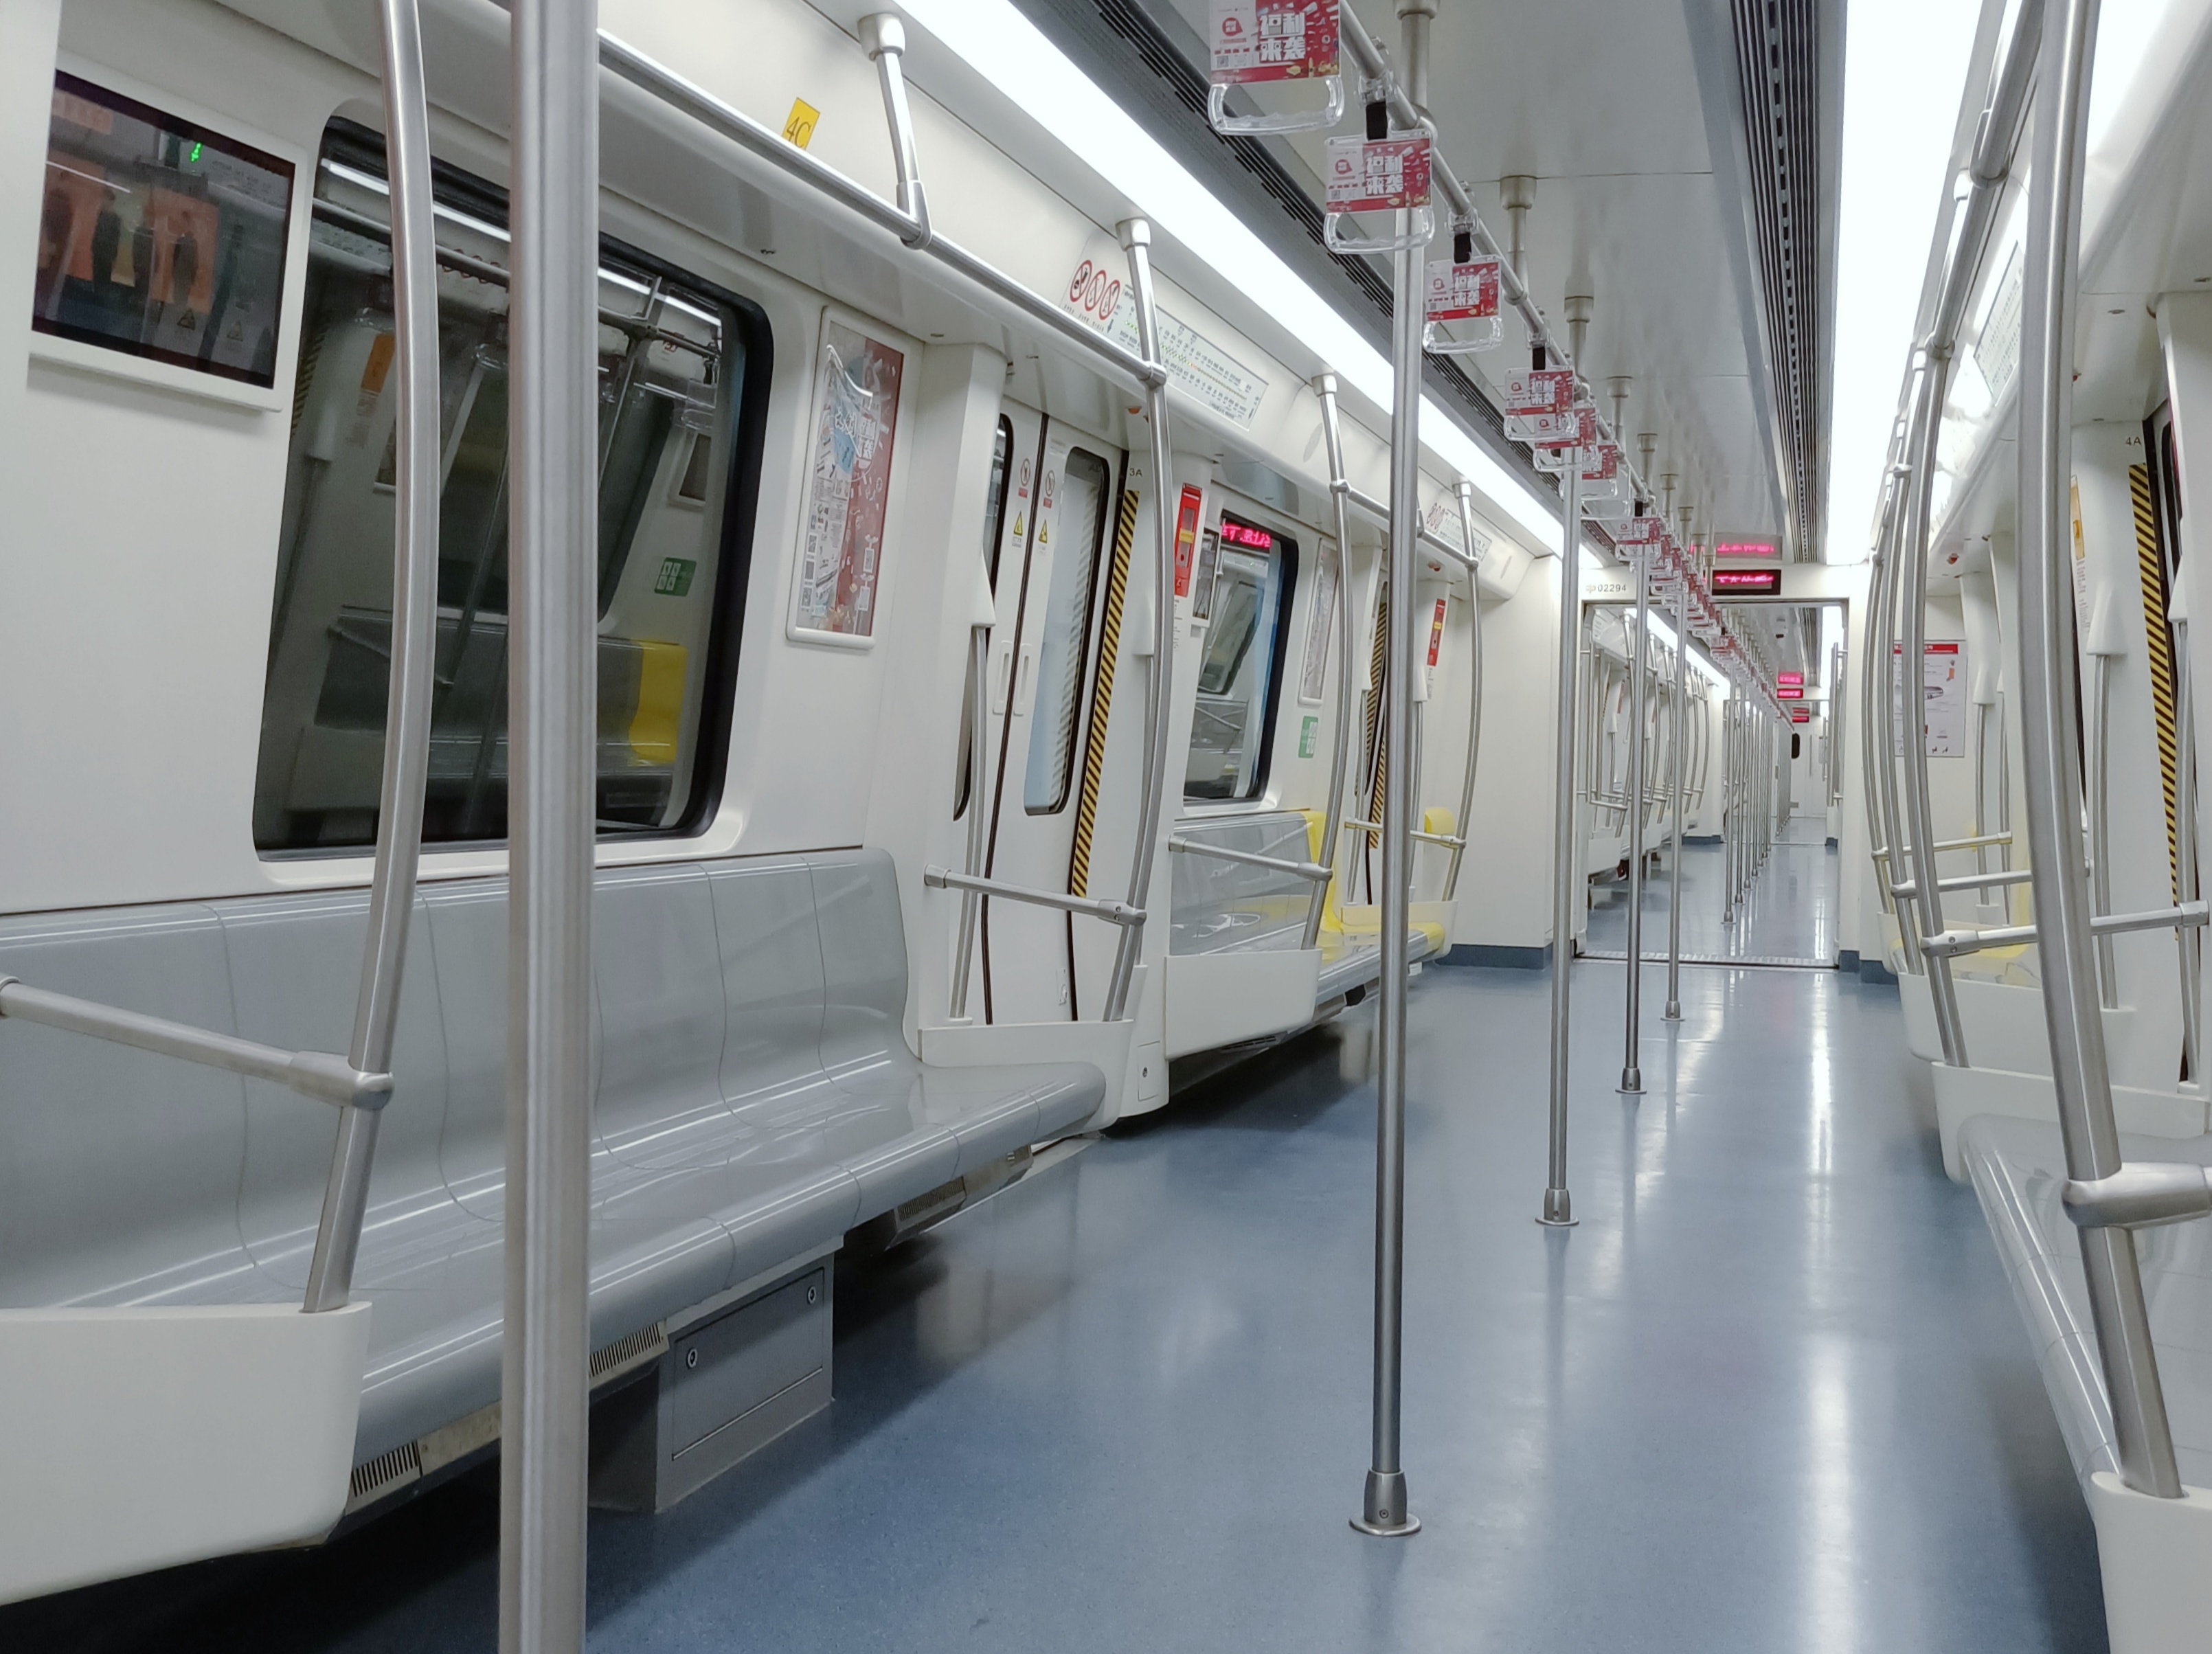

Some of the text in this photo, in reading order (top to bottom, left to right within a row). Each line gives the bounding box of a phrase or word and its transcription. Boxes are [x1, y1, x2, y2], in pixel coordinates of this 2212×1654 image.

[1259, 12, 1305, 38] 福利
[1259, 36, 1305, 62] 来袭
[786, 116, 811, 148] 4C
[1366, 155, 1403, 175] 福利
[1366, 174, 1403, 194] 来袭
[2125, 436, 2141, 446] 4A
[1129, 467, 1143, 477] 3A
[1597, 584, 1627, 592] 02294
